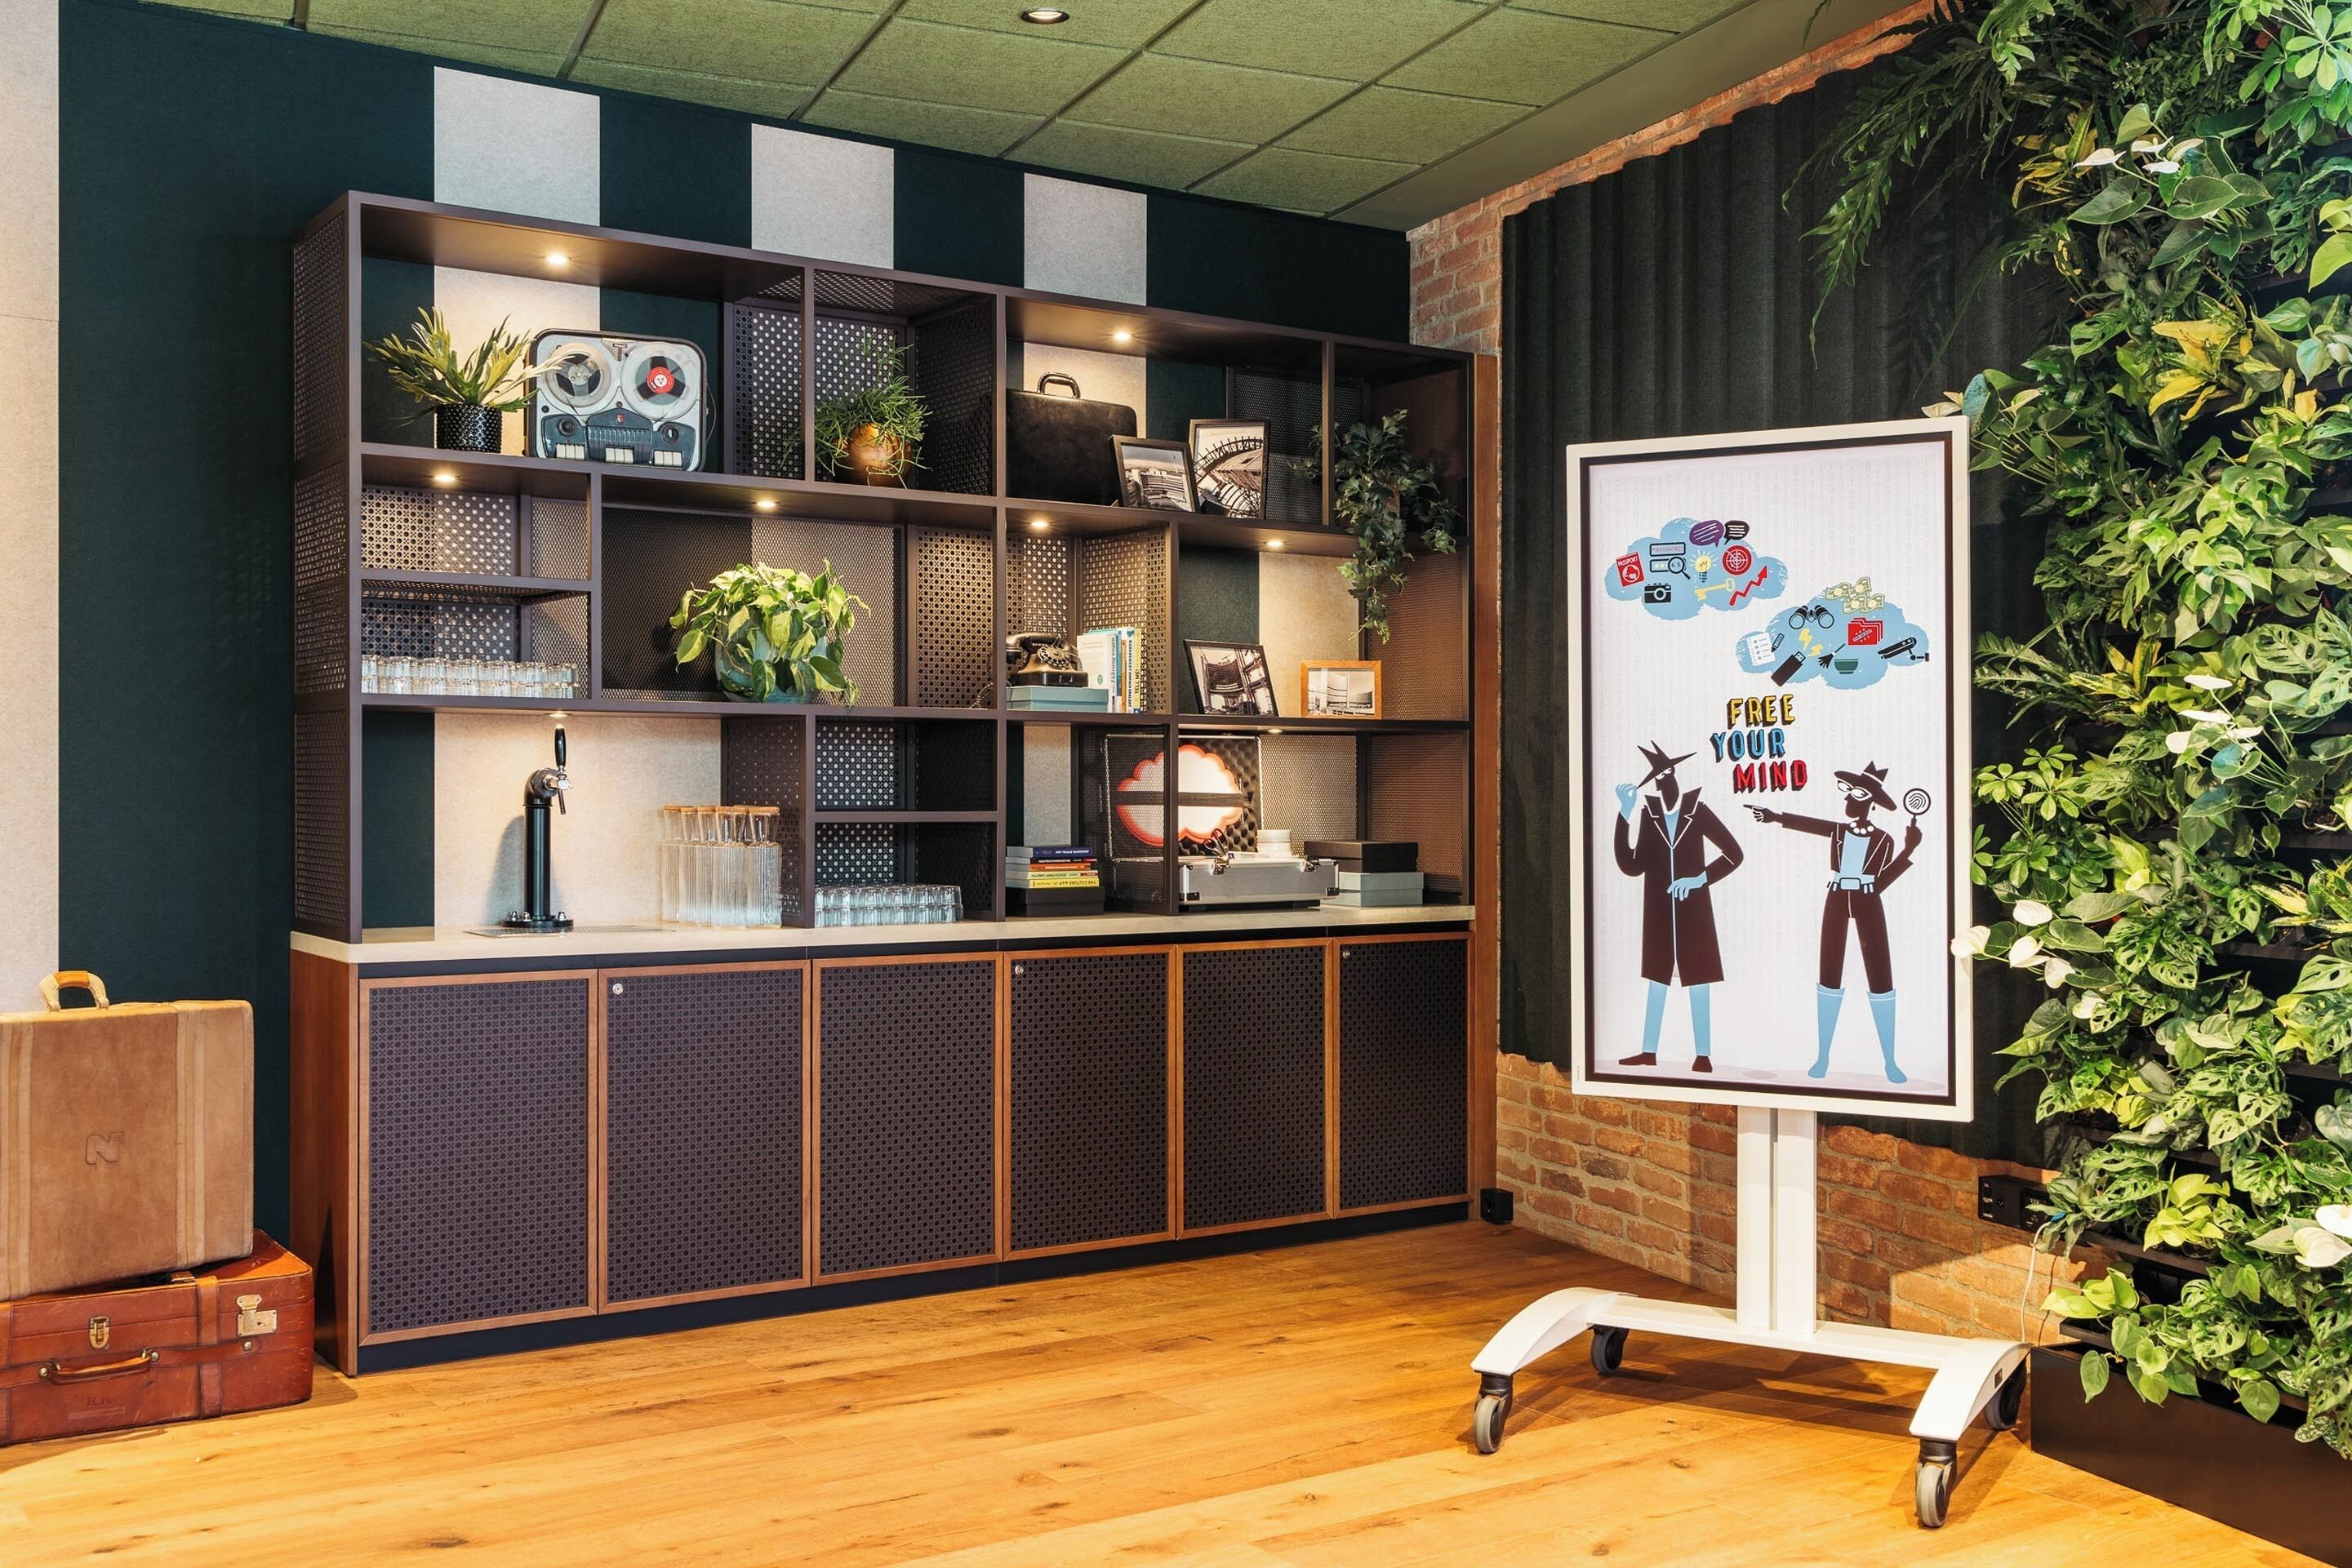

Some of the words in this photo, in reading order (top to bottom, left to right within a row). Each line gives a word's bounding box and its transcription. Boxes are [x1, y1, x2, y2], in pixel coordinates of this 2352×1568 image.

[1617, 556, 1638, 566] PASSPORT
[1727, 694, 1796, 730] FREE
[1710, 728, 1786, 763] YOUR
[1732, 760, 1807, 794] MIND
